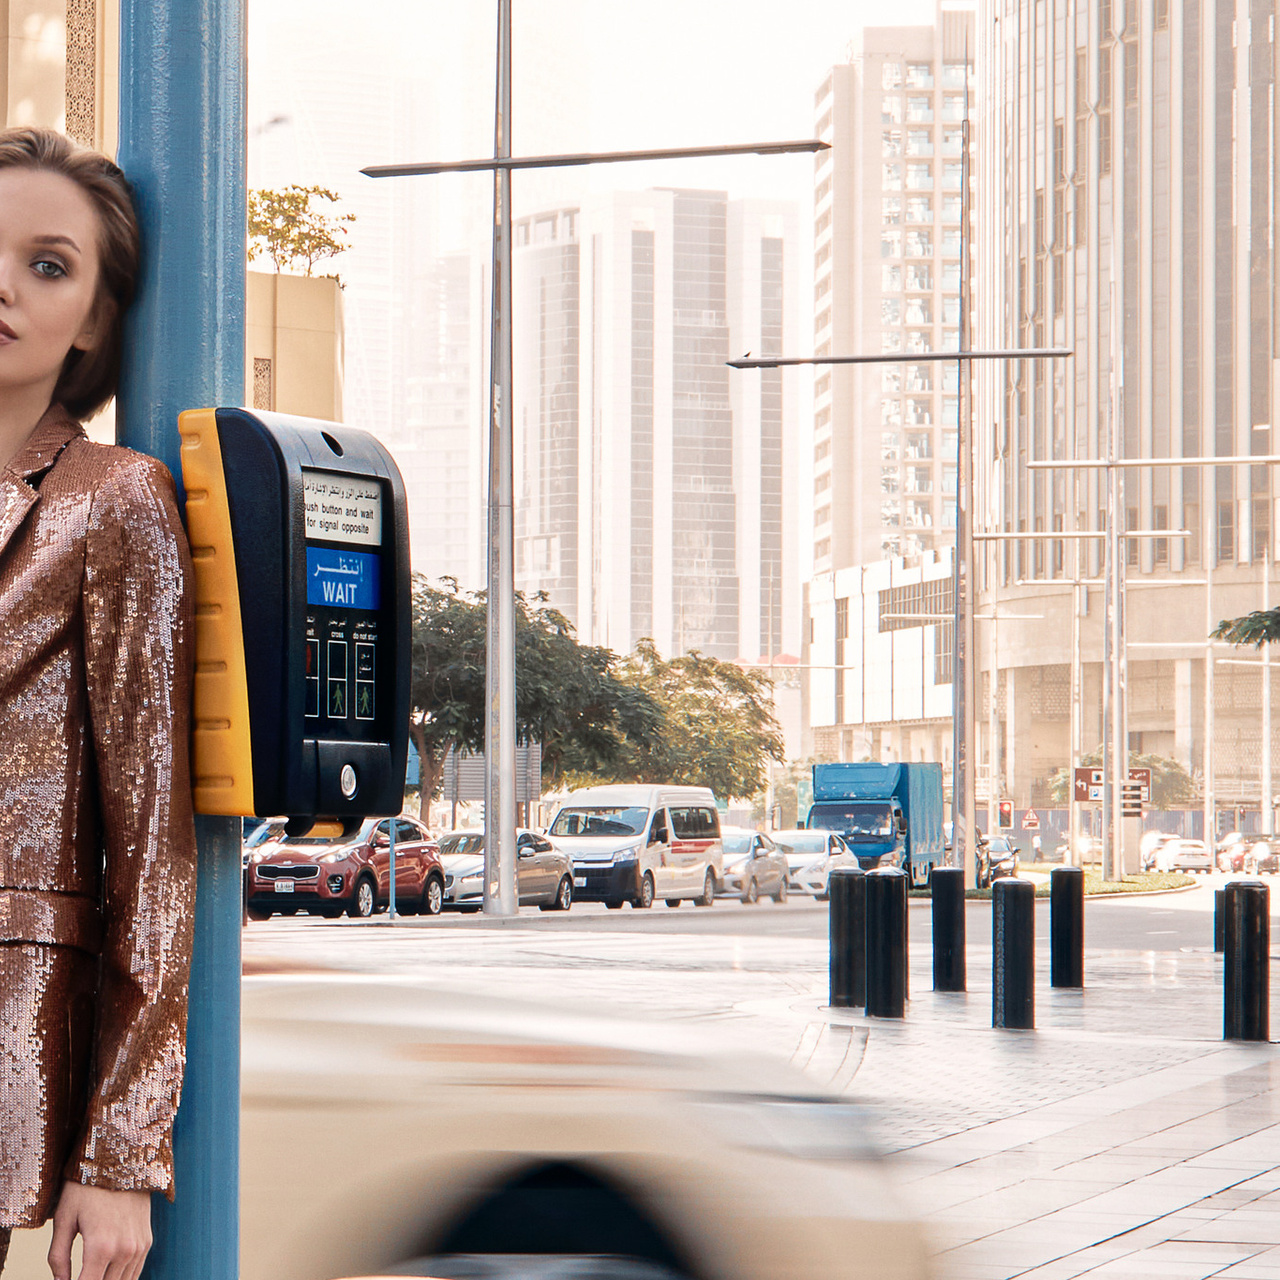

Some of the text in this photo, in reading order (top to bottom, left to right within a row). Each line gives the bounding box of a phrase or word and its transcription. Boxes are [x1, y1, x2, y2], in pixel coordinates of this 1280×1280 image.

[322, 502, 343, 515] button
[345, 507, 358, 518] and
[360, 509, 374, 520] wait
[307, 516, 370, 535] for signal opposite
[322, 581, 357, 604] WAIT
